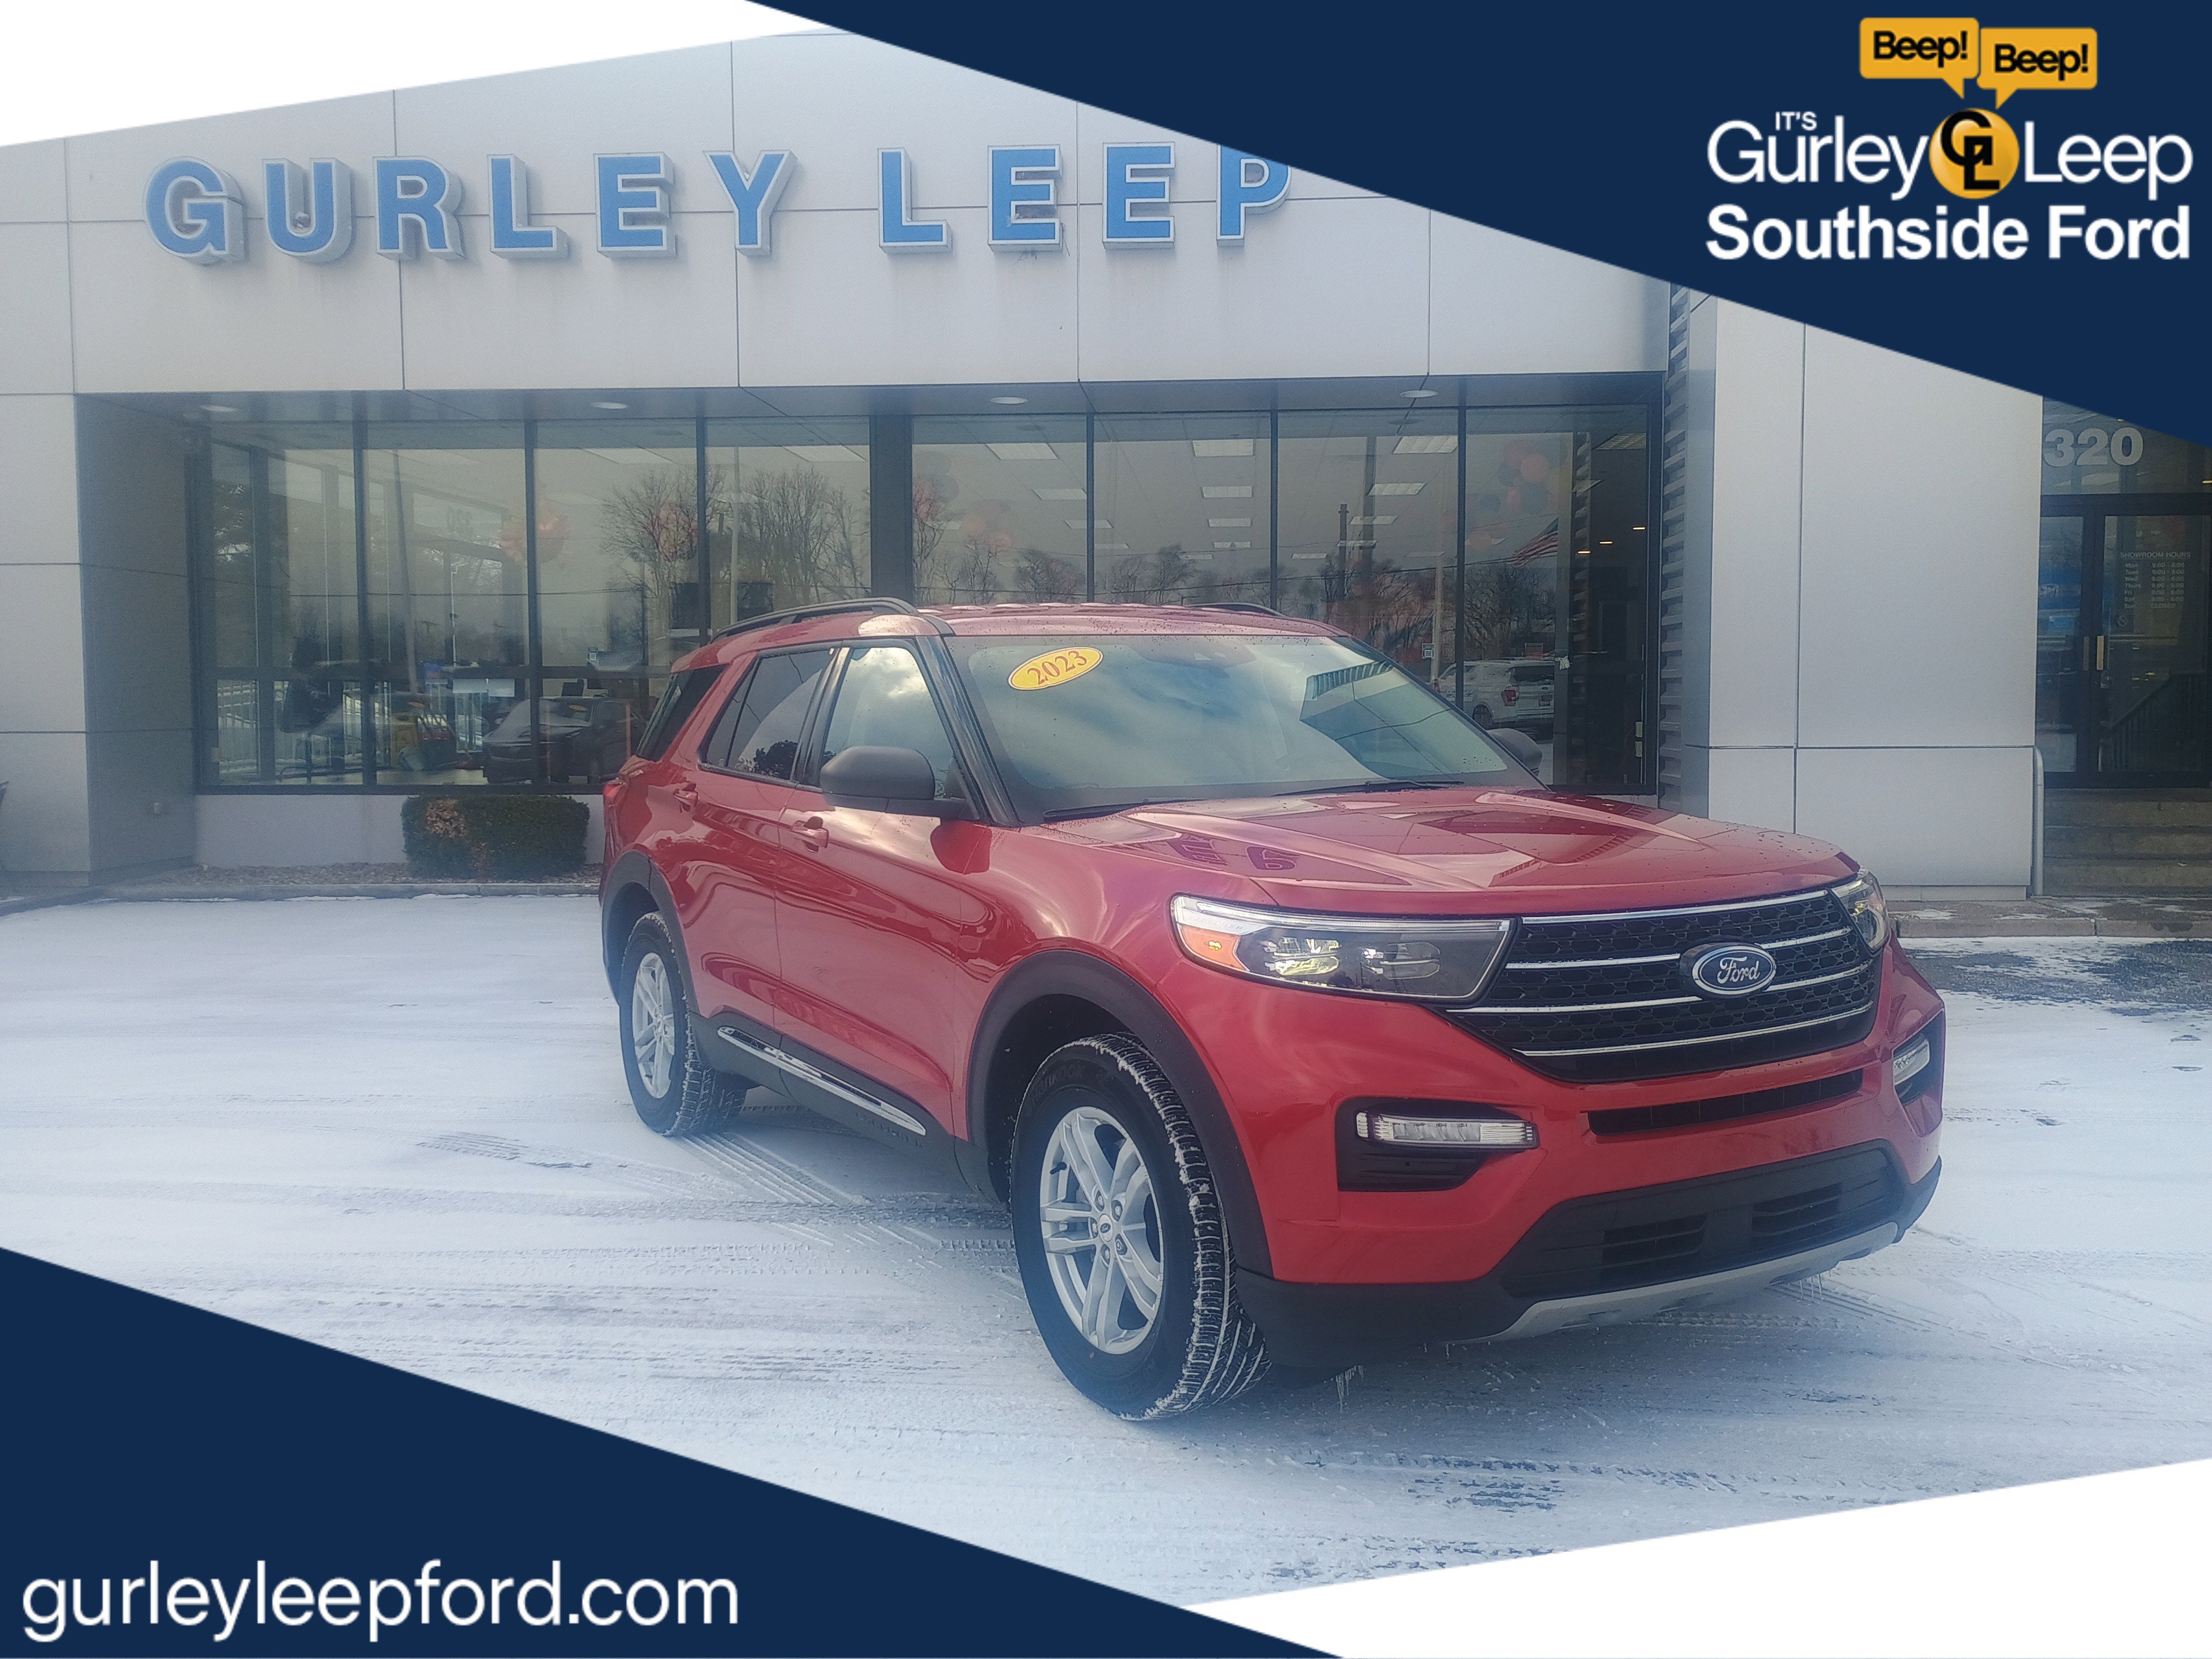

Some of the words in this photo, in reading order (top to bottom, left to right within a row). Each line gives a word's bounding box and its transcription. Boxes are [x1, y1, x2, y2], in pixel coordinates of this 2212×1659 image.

[143, 150, 798, 261] GURLEY
[878, 141, 1291, 252] LEEP
[2044, 427, 2143, 467] 320
[1027, 650, 1087, 685] 2023
[1717, 956, 1761, 984] Ford
